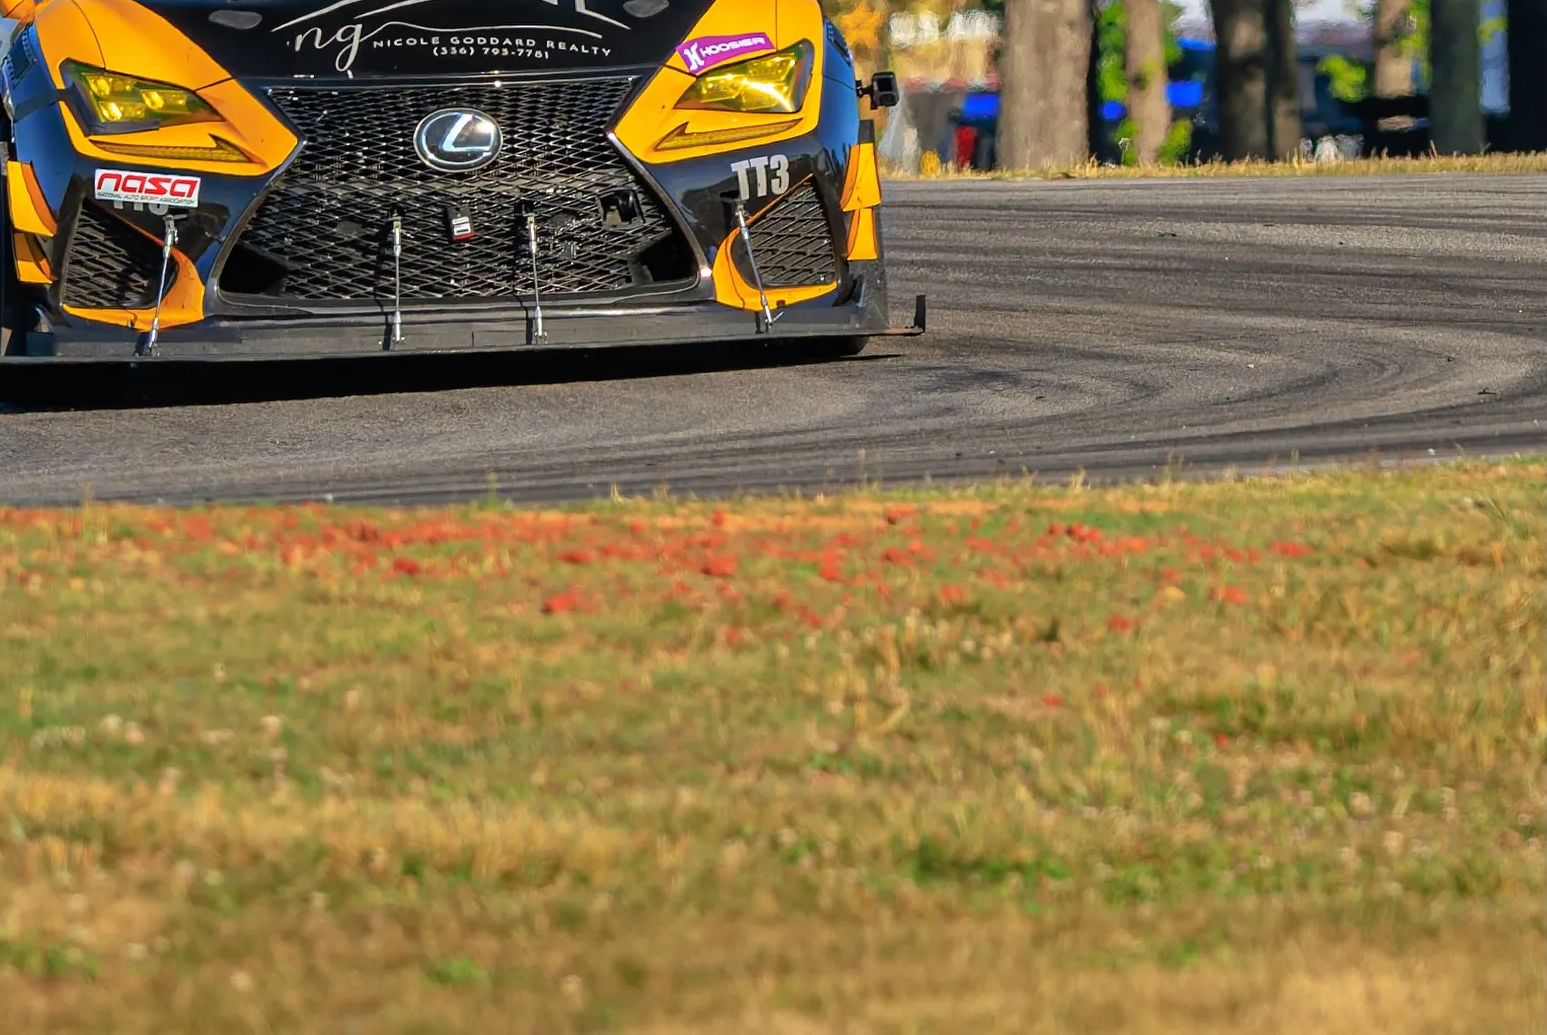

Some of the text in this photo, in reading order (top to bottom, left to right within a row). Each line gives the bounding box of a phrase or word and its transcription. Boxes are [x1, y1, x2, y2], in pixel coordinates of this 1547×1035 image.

[294, 23, 363, 72] ng
[372, 36, 612, 57] NICOLE GODDARD REALTY
[432, 46, 475, 57] (336)
[700, 37, 766, 58] HOOSIER
[730, 154, 790, 201] TT3
